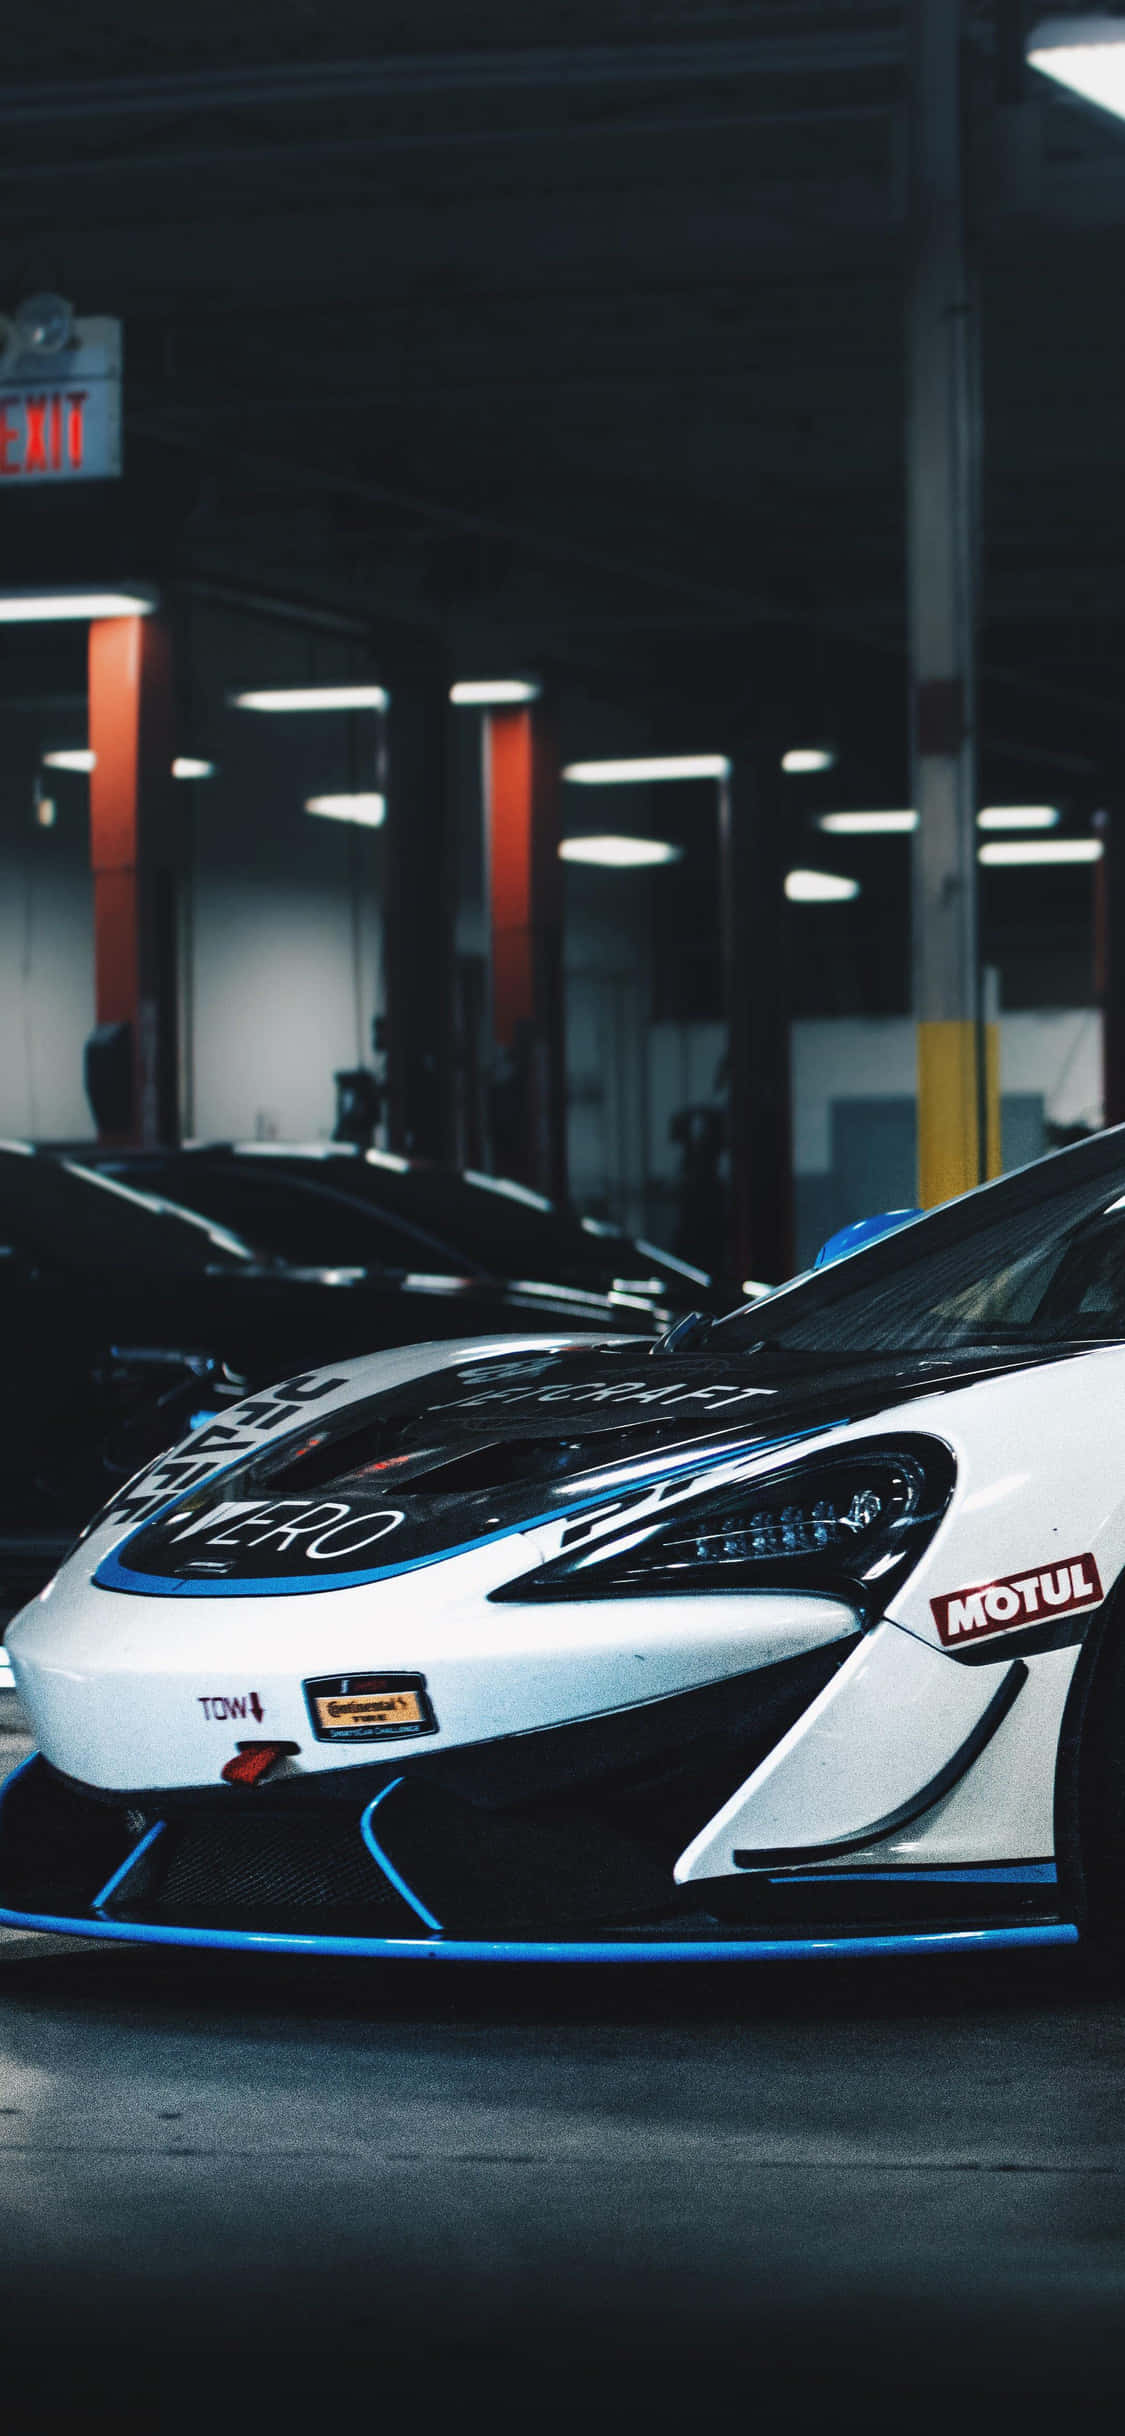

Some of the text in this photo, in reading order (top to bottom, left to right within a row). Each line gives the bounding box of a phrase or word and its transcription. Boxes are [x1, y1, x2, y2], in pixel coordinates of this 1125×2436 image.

[0, 390, 88, 475] EXIT
[427, 1381, 779, 1411] JETCRAFT
[169, 1500, 406, 1560] VERO
[947, 1562, 1094, 1636] MOTUL
[197, 1696, 247, 1721] TOW
